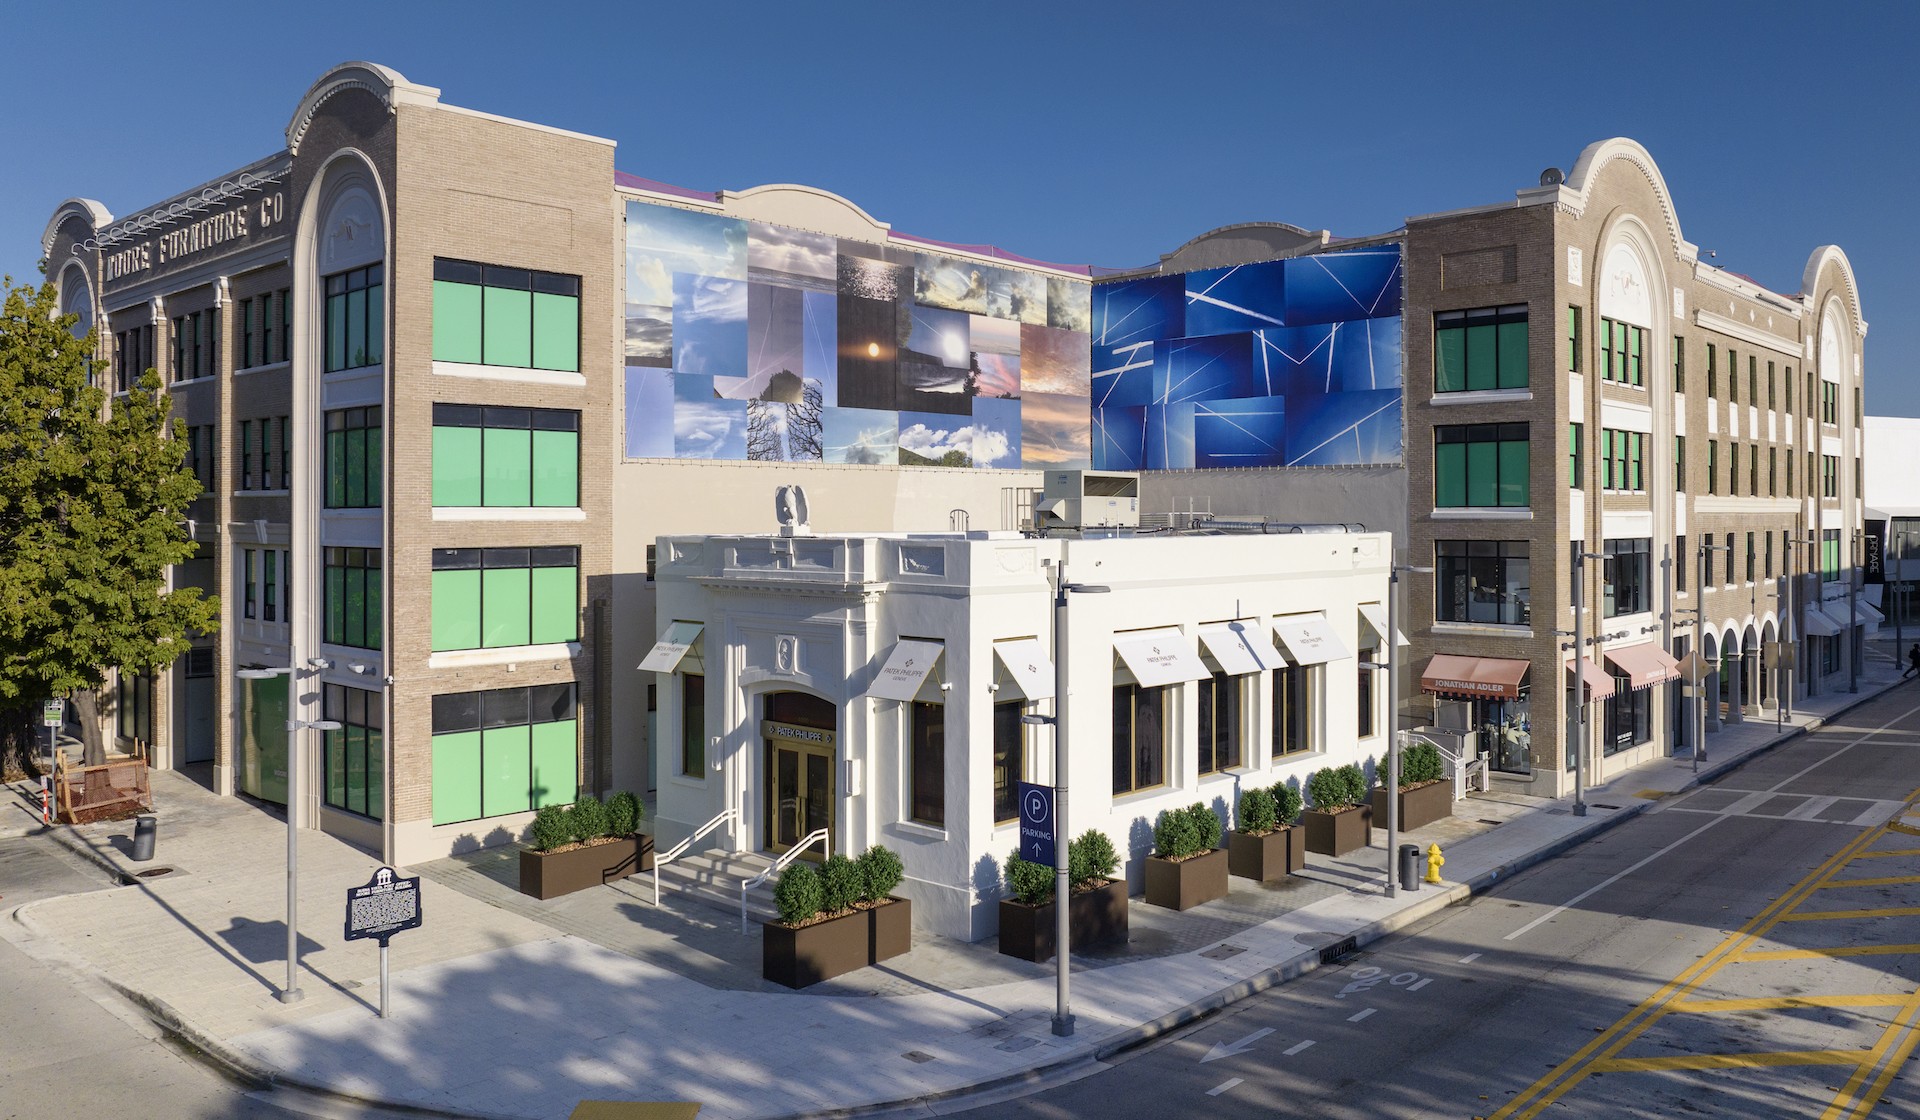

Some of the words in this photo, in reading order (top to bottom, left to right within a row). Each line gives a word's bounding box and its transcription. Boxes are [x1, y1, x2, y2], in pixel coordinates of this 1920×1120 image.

[107, 241, 150, 281] MOORE
[159, 205, 247, 264] FURNITURE
[261, 192, 283, 228] CO
[884, 667, 900, 676] PATEK
[899, 669, 924, 677] PHILIPPE
[1435, 679, 1475, 690] JONATHAN
[1476, 683, 1504, 692] ADLER
[777, 726, 796, 737] PATEK
[795, 730, 822, 742] PHILIPPE
[1032, 798, 1041, 815] P
[1022, 827, 1051, 841] PARKING
